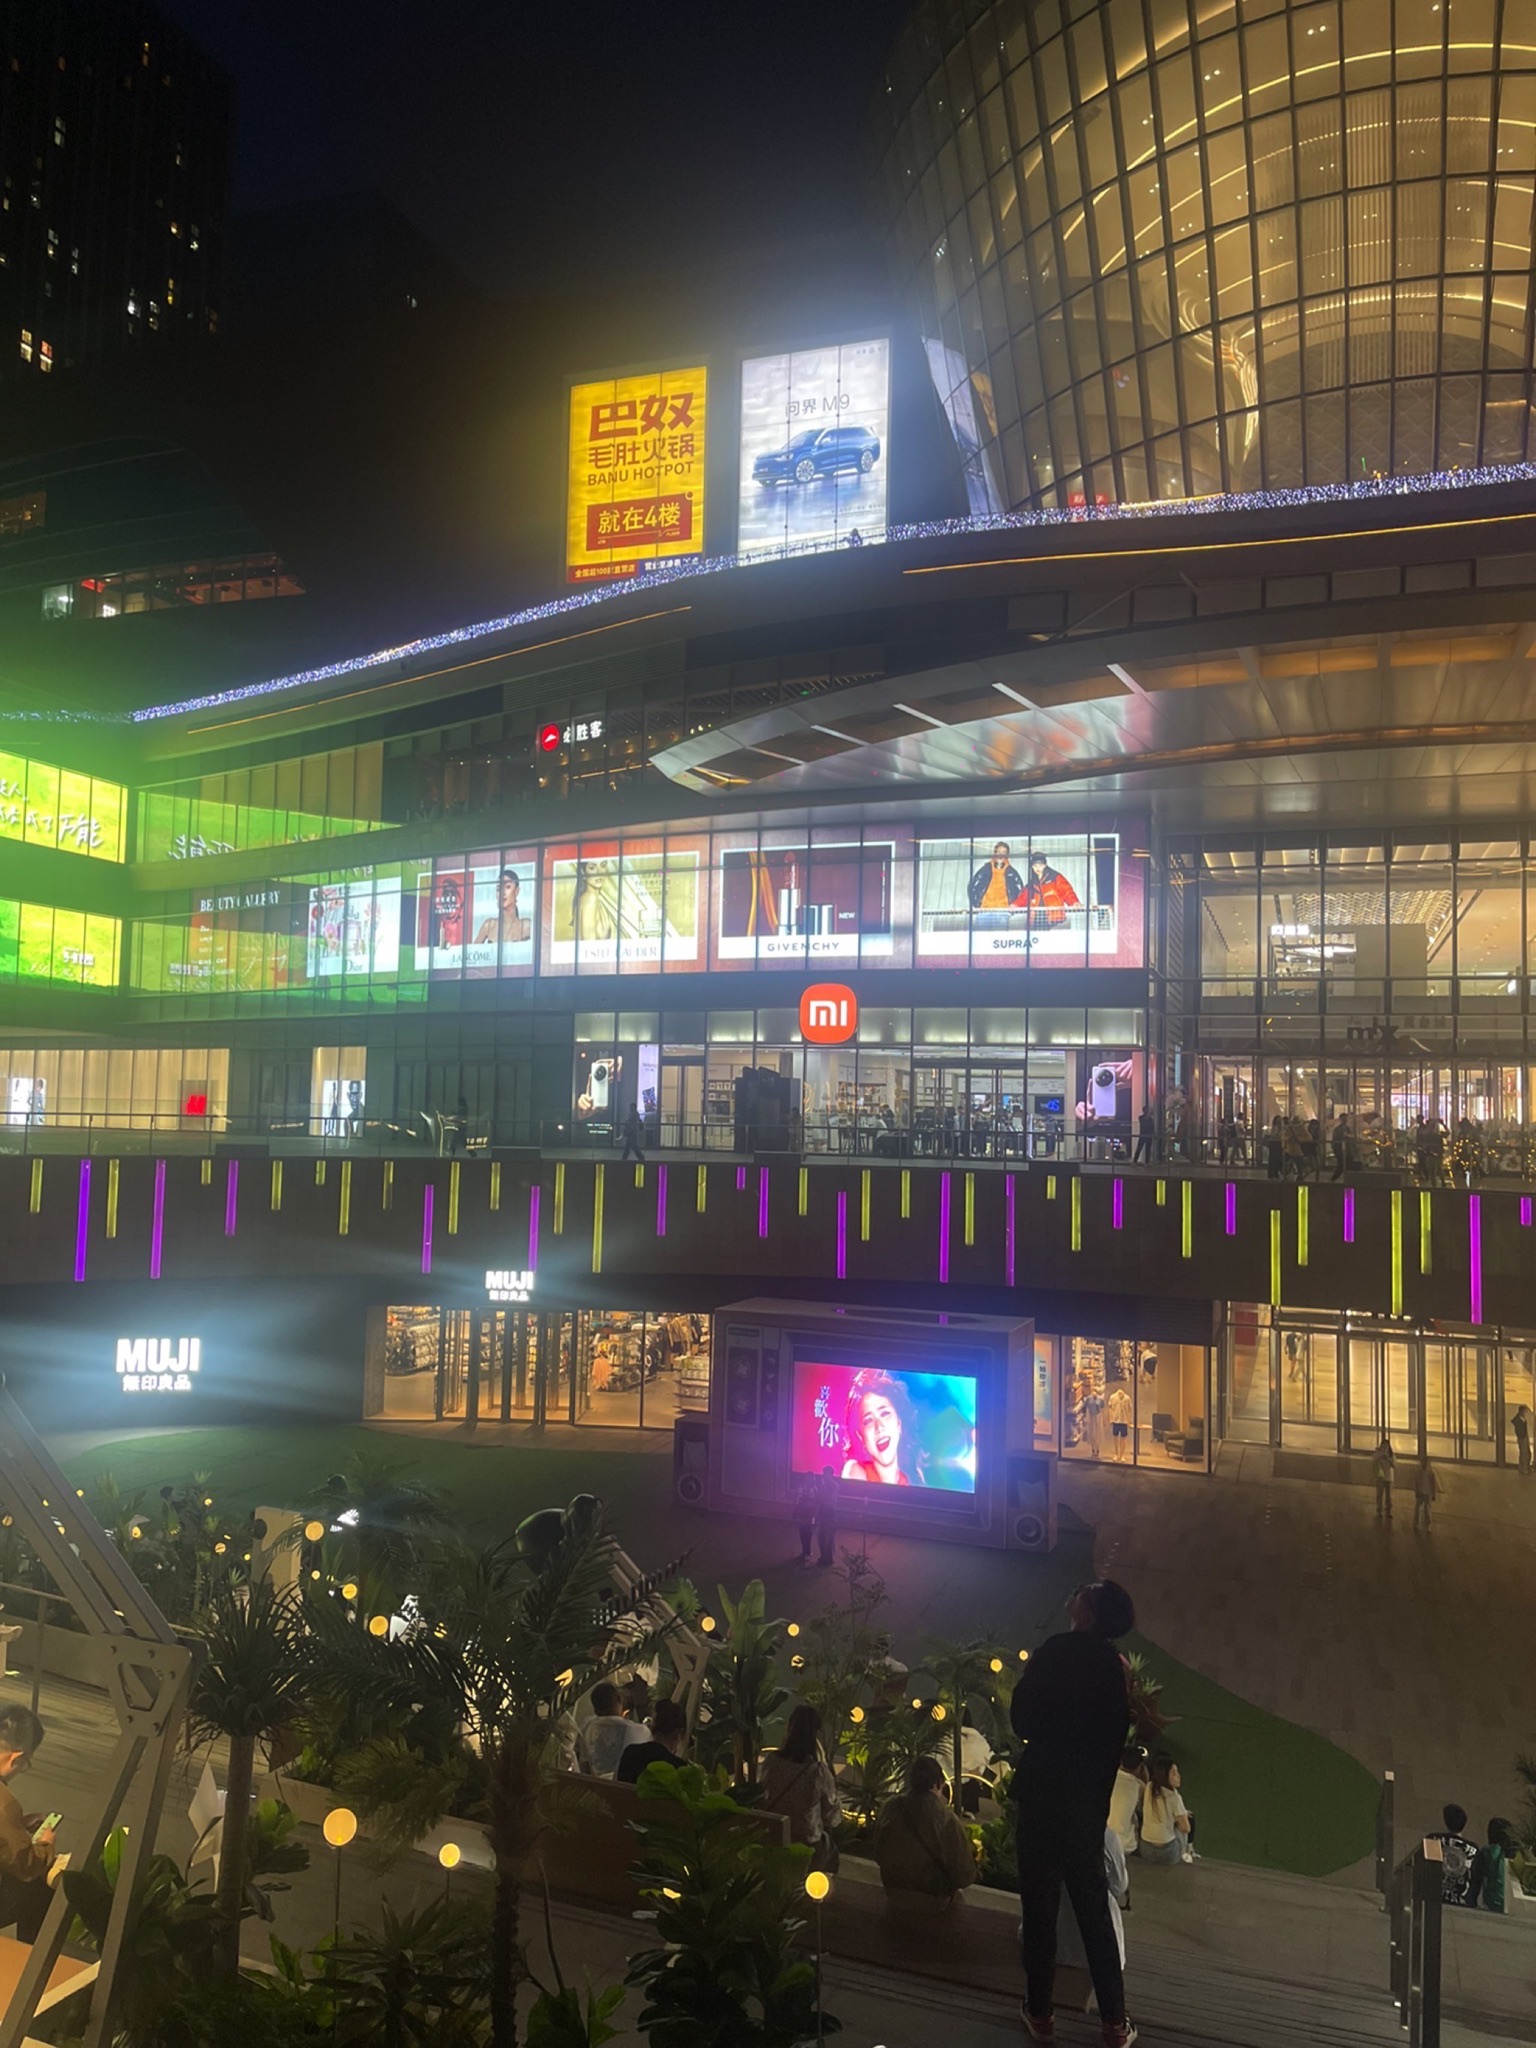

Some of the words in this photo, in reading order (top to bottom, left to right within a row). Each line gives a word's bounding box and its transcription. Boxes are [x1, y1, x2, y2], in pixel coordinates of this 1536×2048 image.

[589, 393, 694, 441] 巴奴
[786, 398, 816, 417] 问界
[823, 394, 850, 411] M9
[589, 433, 694, 469] 毛肚火锅
[588, 469, 628, 485] BANU
[634, 461, 694, 480] HOTPOT
[598, 502, 680, 534] 就在4楼
[201, 896, 236, 912] BEUTY
[767, 942, 839, 952] GIVENCHY
[485, 1271, 533, 1289] MUJI
[116, 1338, 200, 1372] MUJI
[123, 1374, 191, 1391] 無印良品
